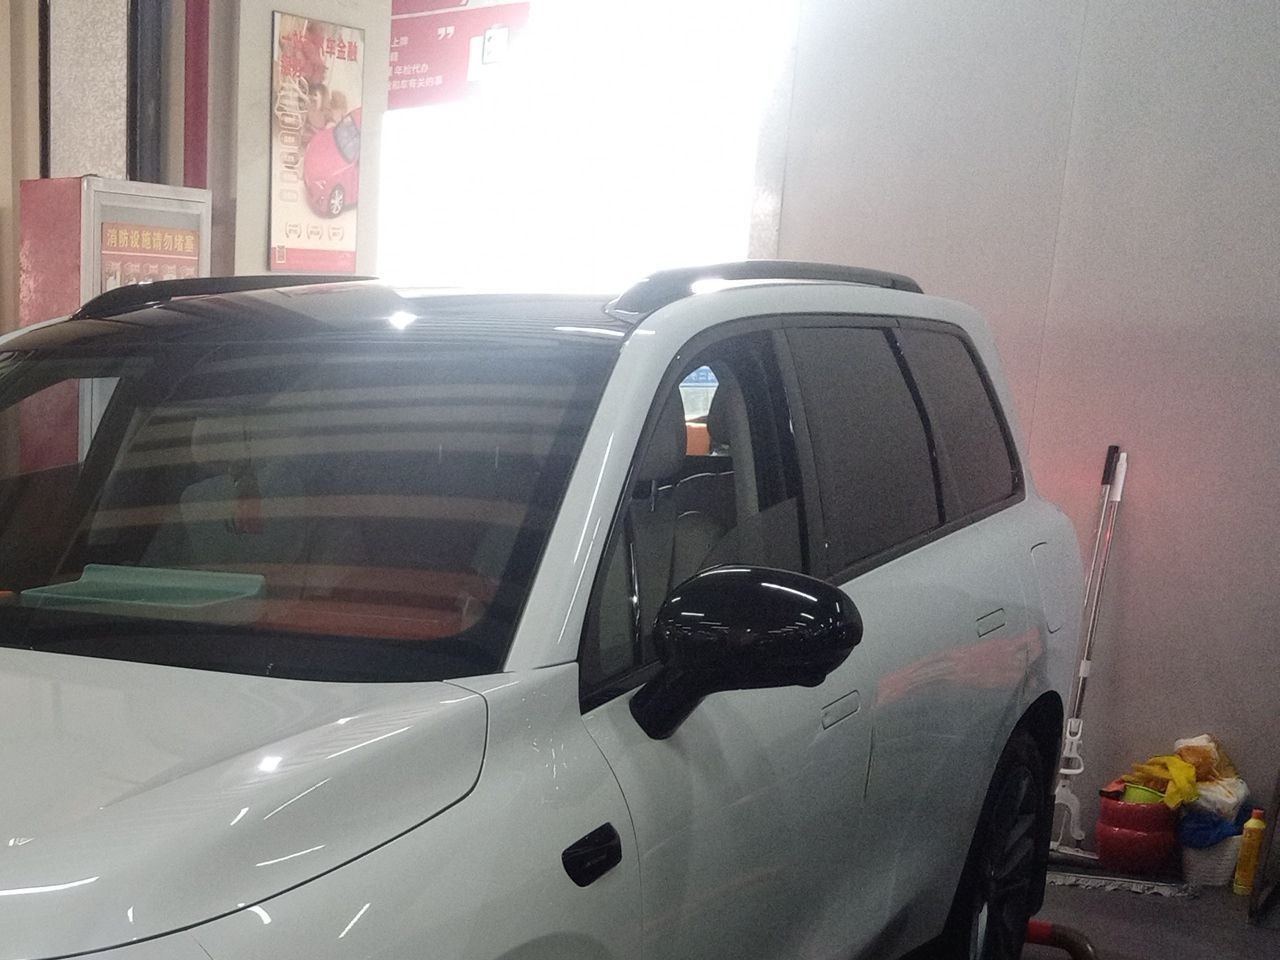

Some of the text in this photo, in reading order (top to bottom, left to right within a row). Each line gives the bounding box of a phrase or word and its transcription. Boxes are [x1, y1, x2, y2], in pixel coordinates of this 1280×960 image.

[106, 228, 195, 252] 消防设施请勿堵塞
